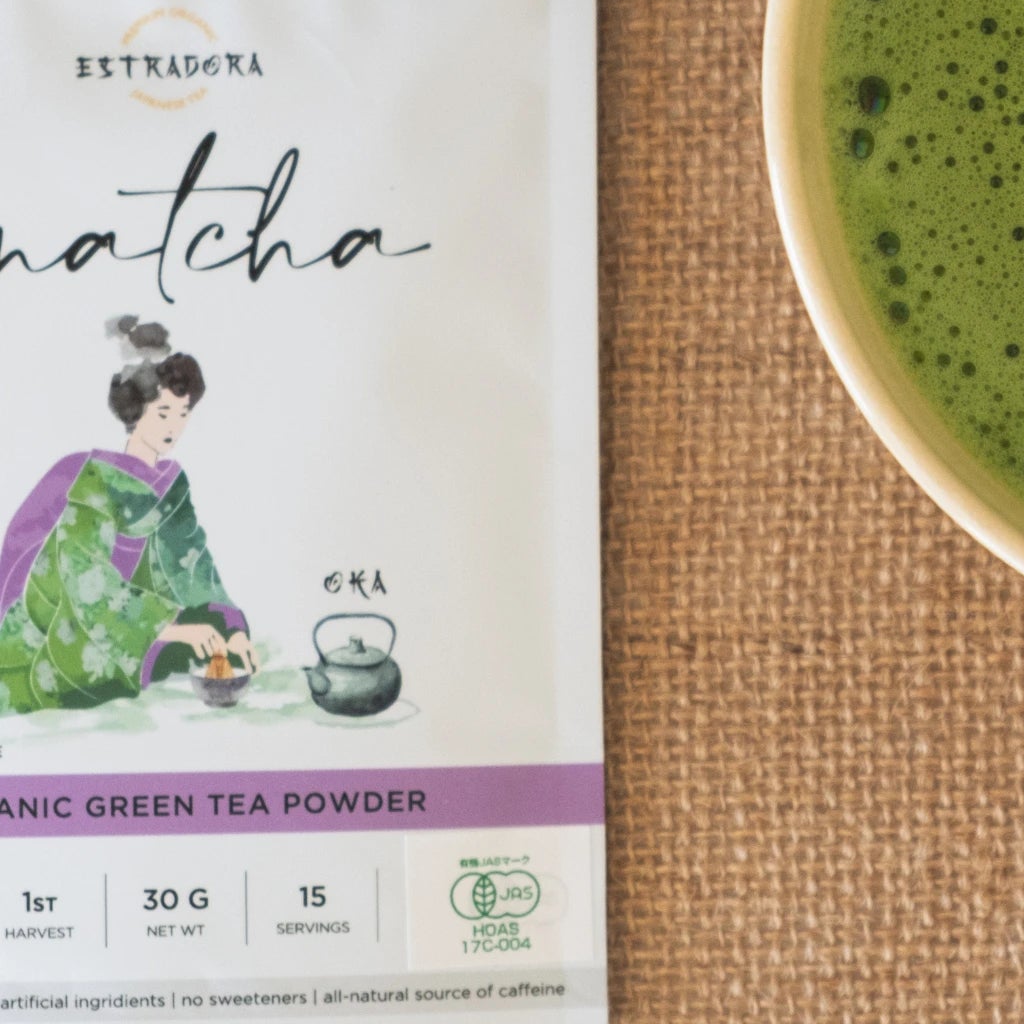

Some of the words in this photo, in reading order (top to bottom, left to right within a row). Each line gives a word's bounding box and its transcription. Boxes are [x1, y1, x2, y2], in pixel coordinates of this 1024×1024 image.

[75, 51, 264, 79] ESTRADORA
[323, 568, 388, 600] OKA
[0, 796, 72, 819] ANIC
[86, 794, 194, 818] GREEN
[208, 792, 270, 816] TEA
[284, 789, 427, 815] POWDER
[143, 887, 179, 911] 30
[189, 887, 209, 911] G
[300, 885, 327, 908] 15
[499, 885, 534, 902] JAS
[4, 926, 74, 940] HARVEST
[147, 924, 177, 938] NET
[180, 924, 205, 937] WT
[276, 921, 351, 936] SERVINGS
[472, 921, 519, 937] HOAS
[462, 935, 532, 954] 17C-004
[0, 993, 69, 1010] artificial
[74, 993, 166, 1013] ingridients
[181, 995, 204, 1007] no
[209, 992, 308, 1007] sweeteners
[322, 987, 410, 1005] all-natural
[414, 987, 472, 1002] source
[475, 983, 494, 1000] of
[497, 981, 566, 999] caffeine
